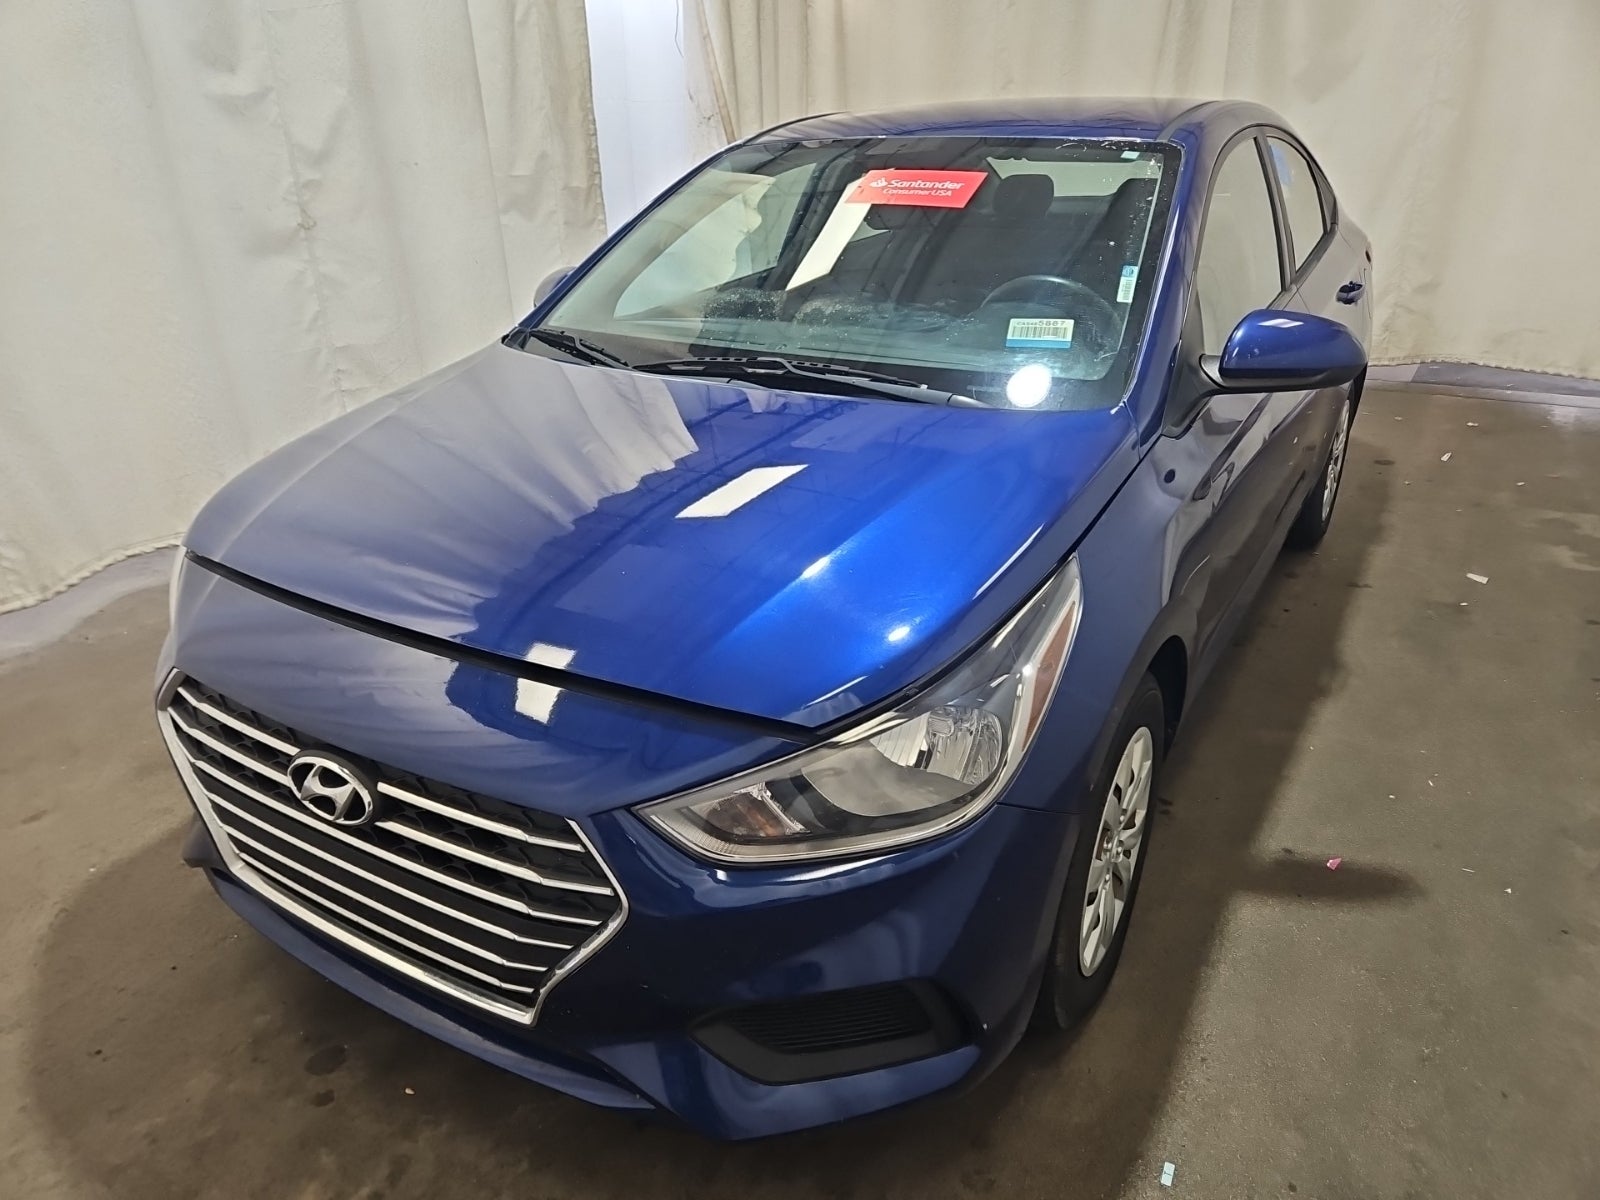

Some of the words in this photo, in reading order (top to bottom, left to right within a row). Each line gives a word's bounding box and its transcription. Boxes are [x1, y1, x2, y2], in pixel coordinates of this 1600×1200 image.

[888, 179, 964, 190] Santander
[883, 188, 931, 196] Consumer
[931, 189, 952, 197] USA
